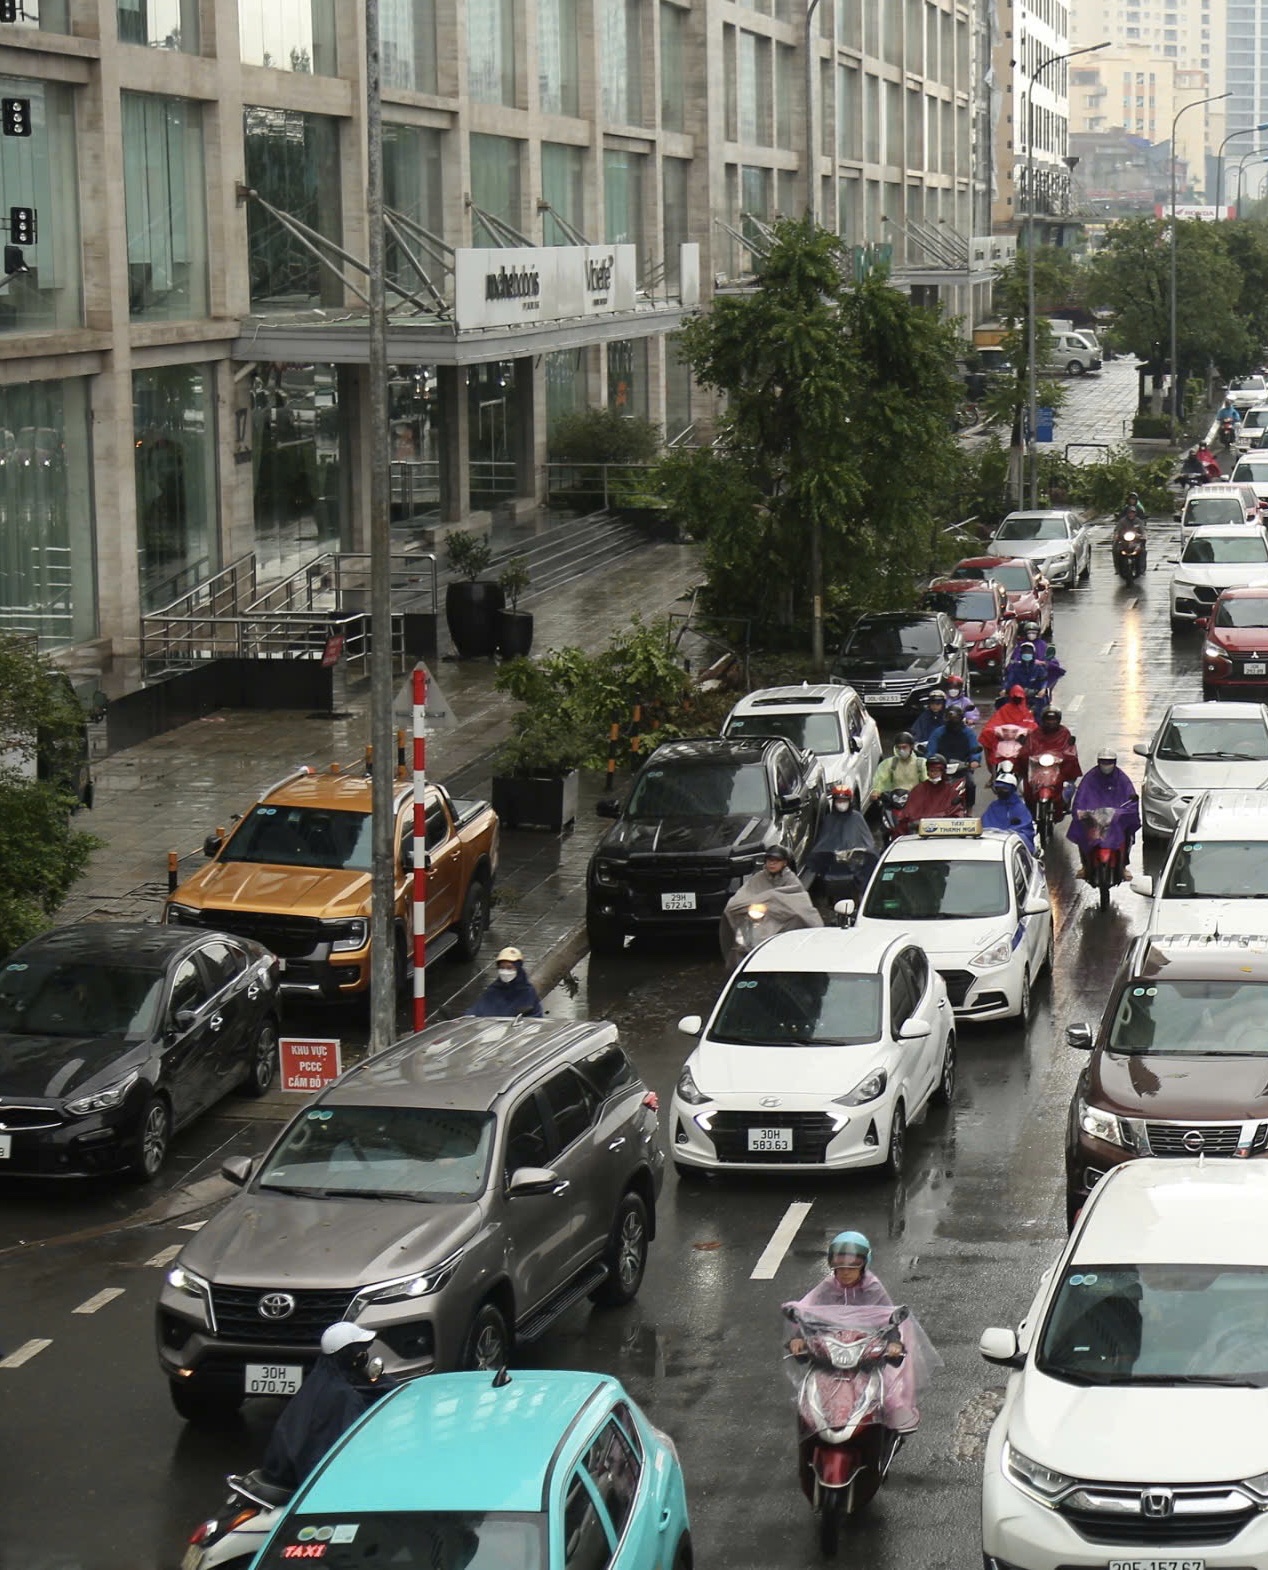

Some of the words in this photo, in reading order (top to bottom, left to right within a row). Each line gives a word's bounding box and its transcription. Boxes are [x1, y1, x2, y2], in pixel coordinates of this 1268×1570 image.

[291, 1045, 309, 1055] KHU
[311, 1045, 328, 1058] VỰC
[299, 1061, 322, 1072] PCCC
[760, 1129, 780, 1139] 30H
[752, 1140, 788, 1150] 583.63
[261, 1366, 286, 1379] 30H
[251, 1380, 296, 1394] 070.75
[284, 1544, 326, 1558] TAXI
